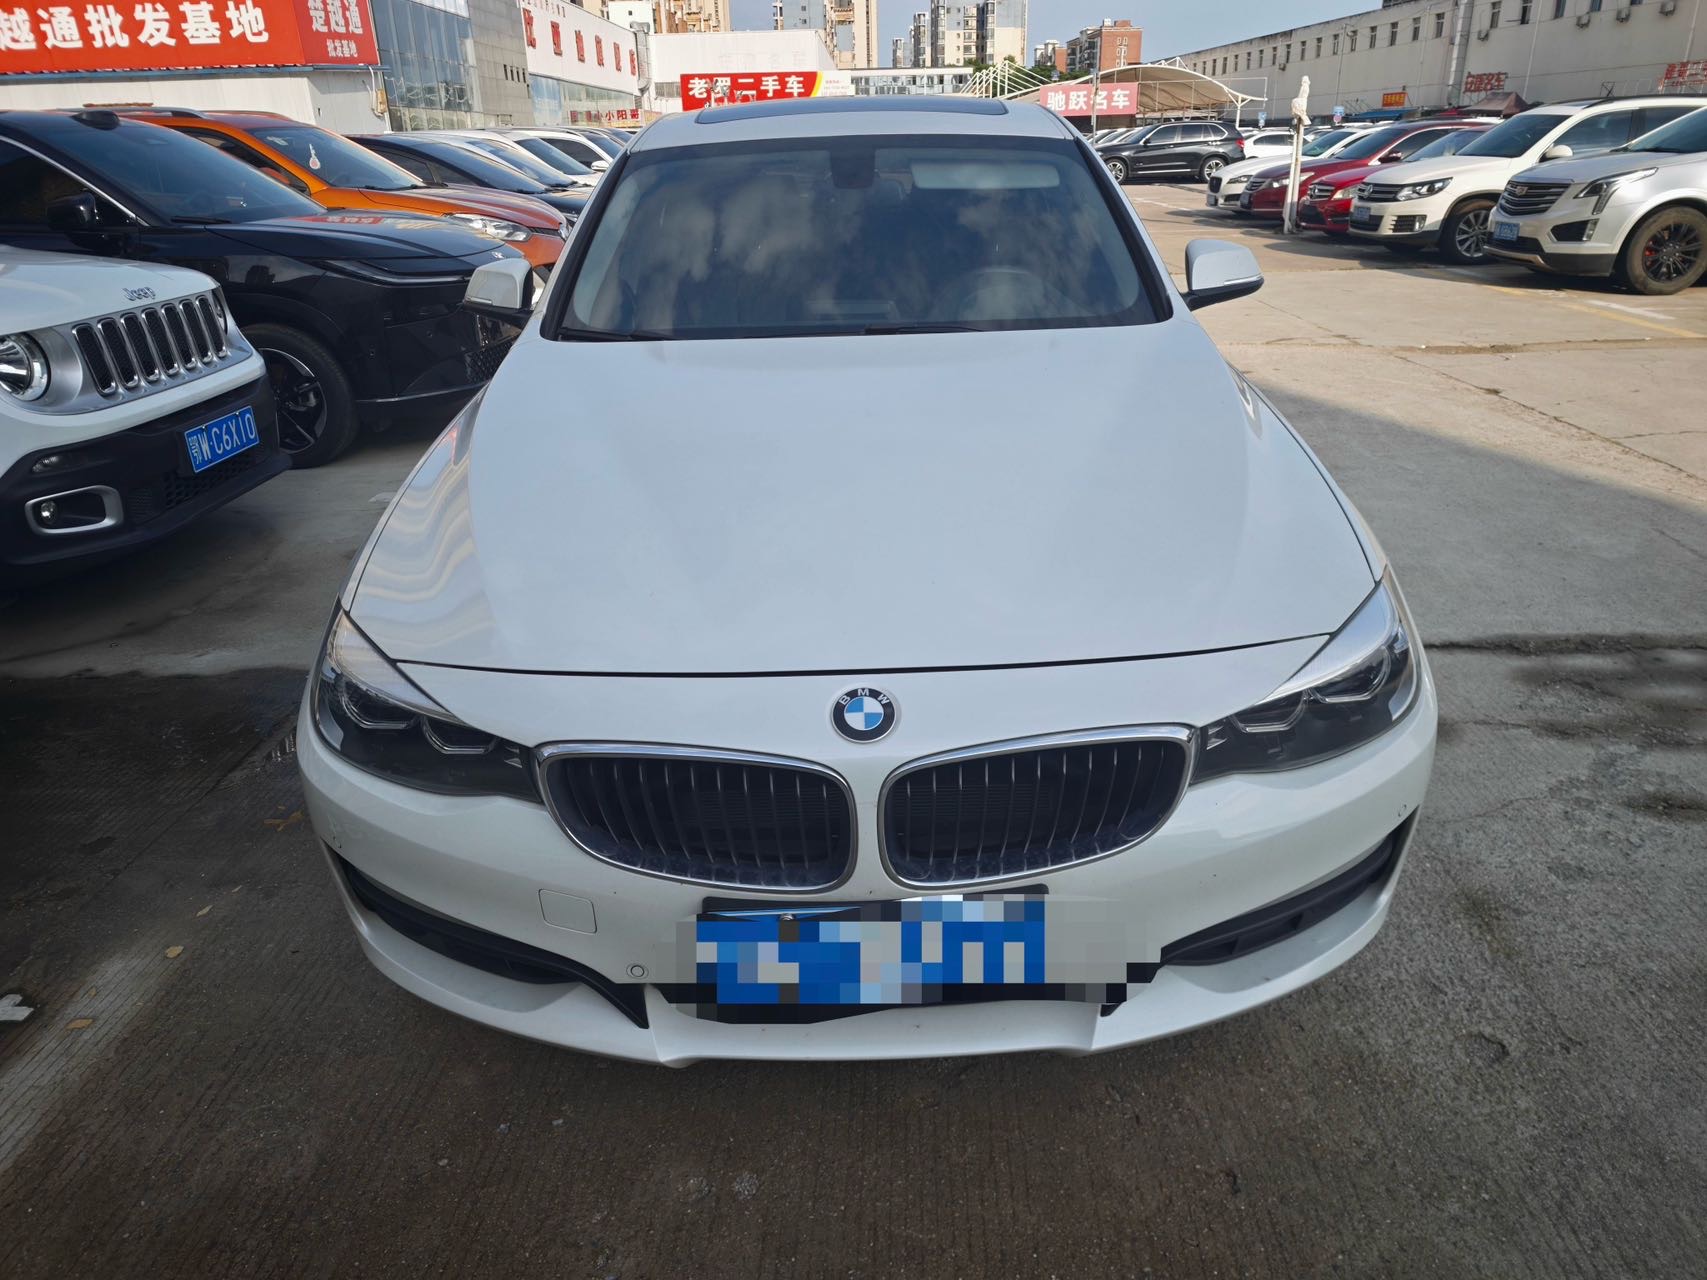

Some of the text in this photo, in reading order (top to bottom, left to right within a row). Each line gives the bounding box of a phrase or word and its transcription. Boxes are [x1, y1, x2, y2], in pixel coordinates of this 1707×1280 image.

[0, 0, 269, 50] 越通批发基地
[688, 75, 805, 98] 老罗二手车
[1047, 89, 1130, 111] 驰跃名车
[121, 286, 156, 301] Jeep
[838, 688, 890, 705] BMW
